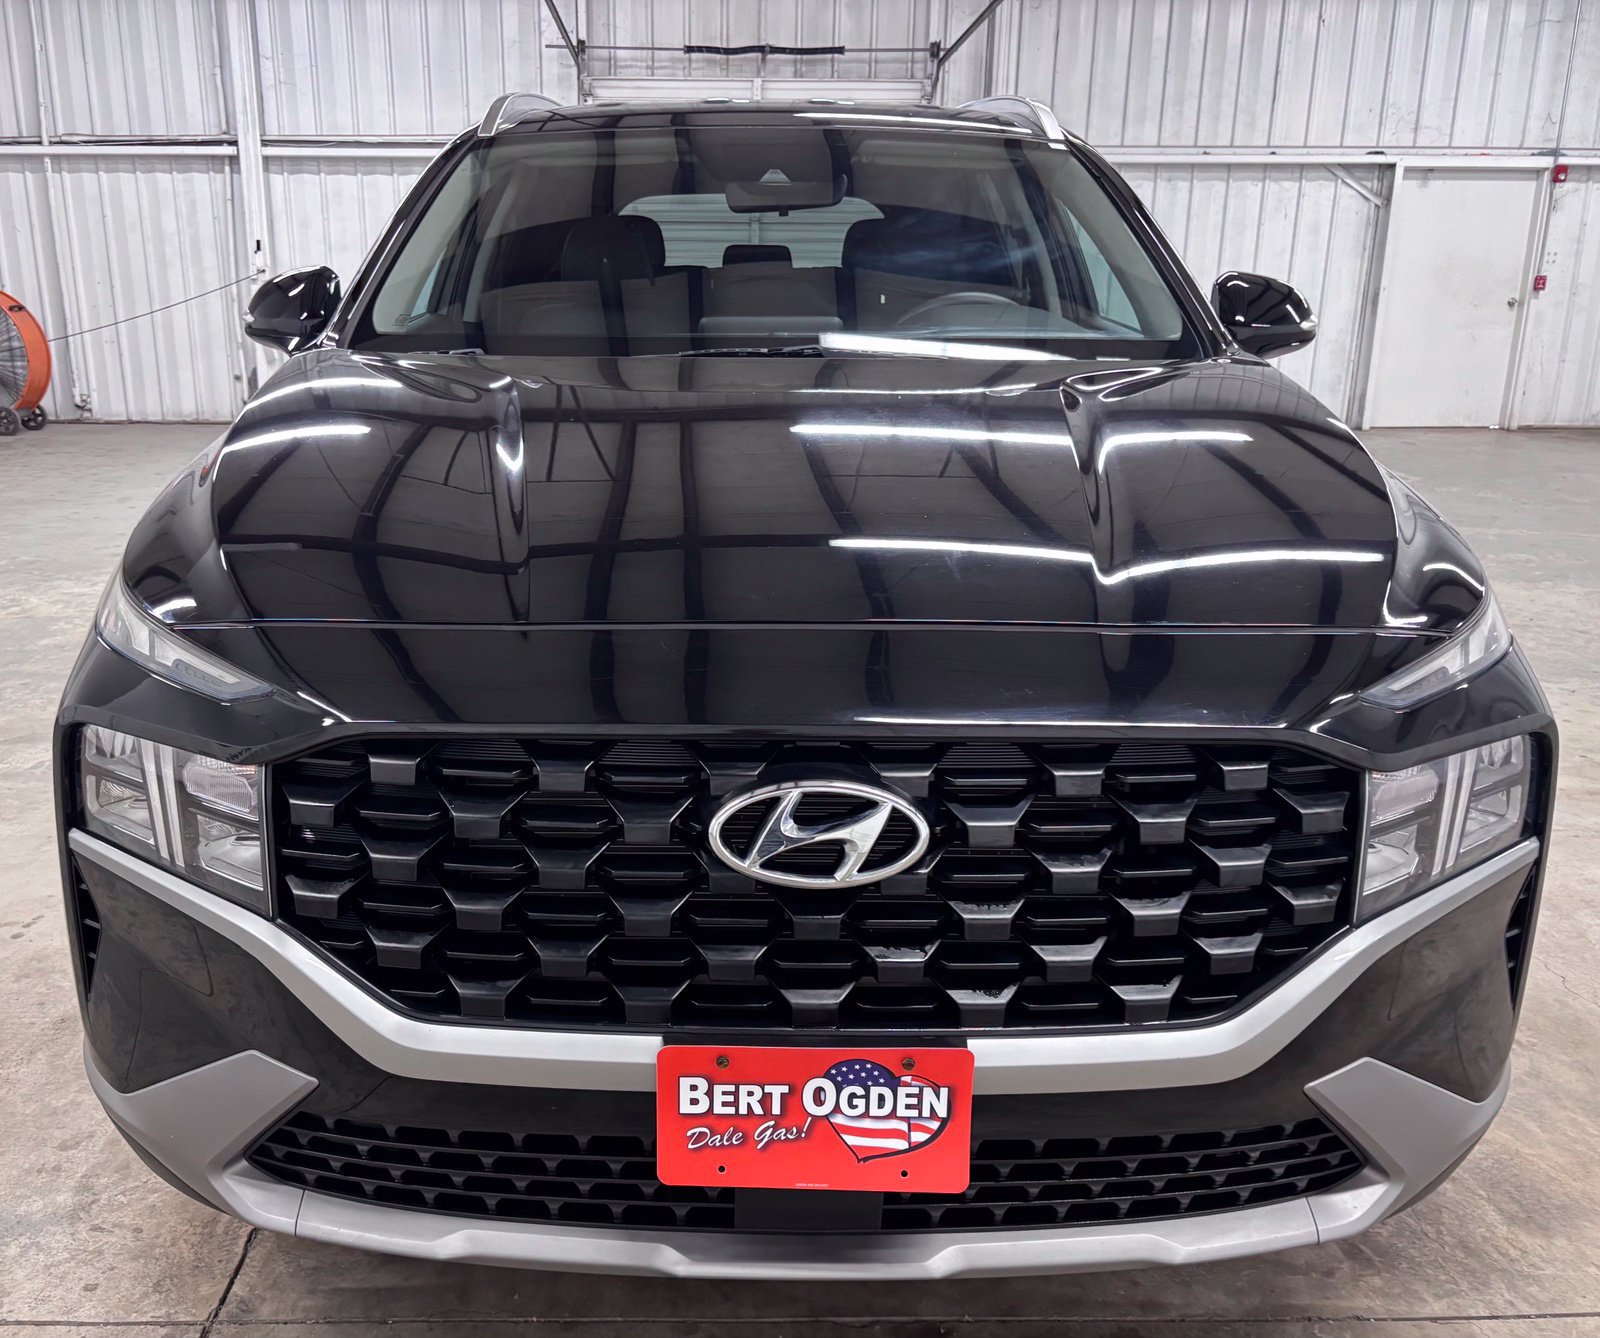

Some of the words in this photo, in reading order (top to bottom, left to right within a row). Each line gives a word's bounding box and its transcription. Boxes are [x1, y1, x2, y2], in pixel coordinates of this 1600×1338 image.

[679, 1076, 790, 1116] BERT
[802, 1076, 949, 1118] OGDEN
[685, 1126, 744, 1149] Dale
[753, 1116, 812, 1150] Gas!
